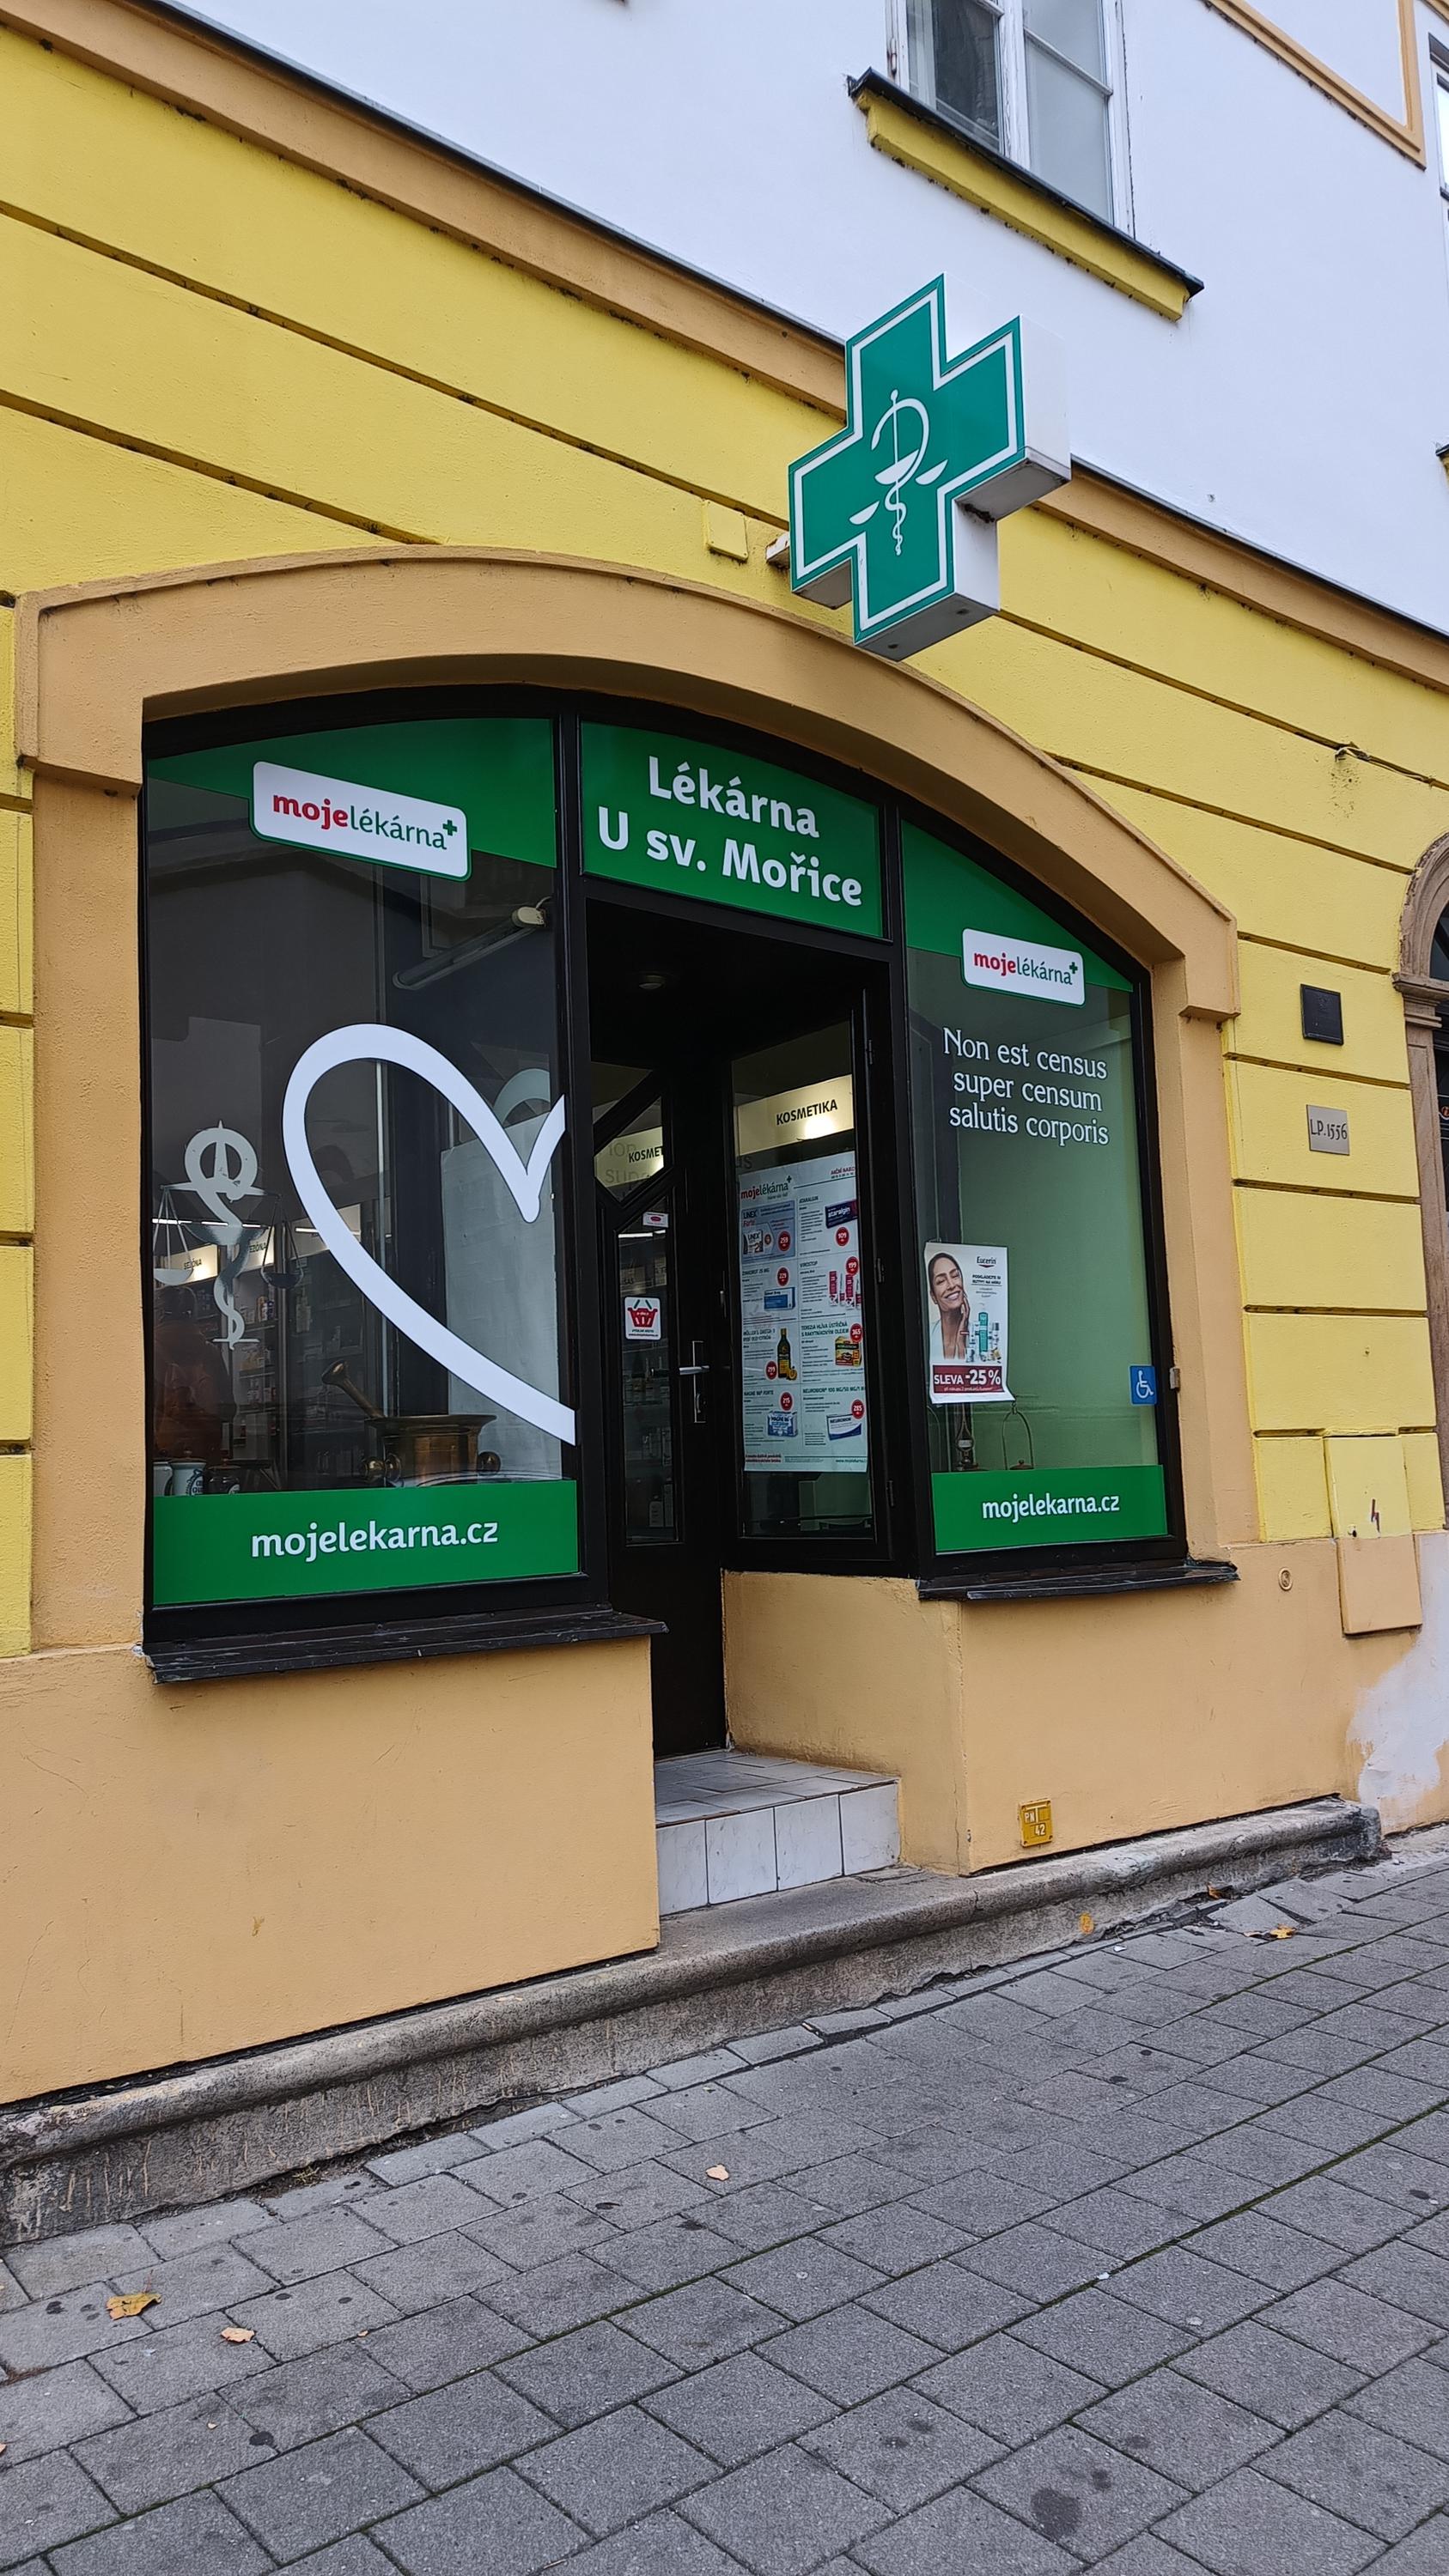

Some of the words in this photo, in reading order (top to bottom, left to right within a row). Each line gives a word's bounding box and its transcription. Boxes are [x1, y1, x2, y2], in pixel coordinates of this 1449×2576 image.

[649, 756, 820, 838] Lékárna
[599, 805, 629, 851] U
[646, 829, 707, 872] sv.
[721, 838, 862, 907] Mořice
[943, 1027, 989, 1060] Non
[997, 1042, 1030, 1067] est
[1037, 1050, 1108, 1079] census
[776, 1098, 838, 1126] KOSMETIKA
[953, 1071, 1014, 1102] super
[1021, 1080, 1103, 1112] censum
[949, 1102, 1020, 1133] salutis
[1026, 1116, 1110, 1147] corporis
[977, 1255, 996, 1265] Eucerin
[934, 1374, 965, 1385] SLEVA
[982, 1492, 1120, 1523] mojelekarna.cz
[251, 1521, 499, 1563] mojelekarna.cz
[1035, 1823, 1046, 1837] 42
